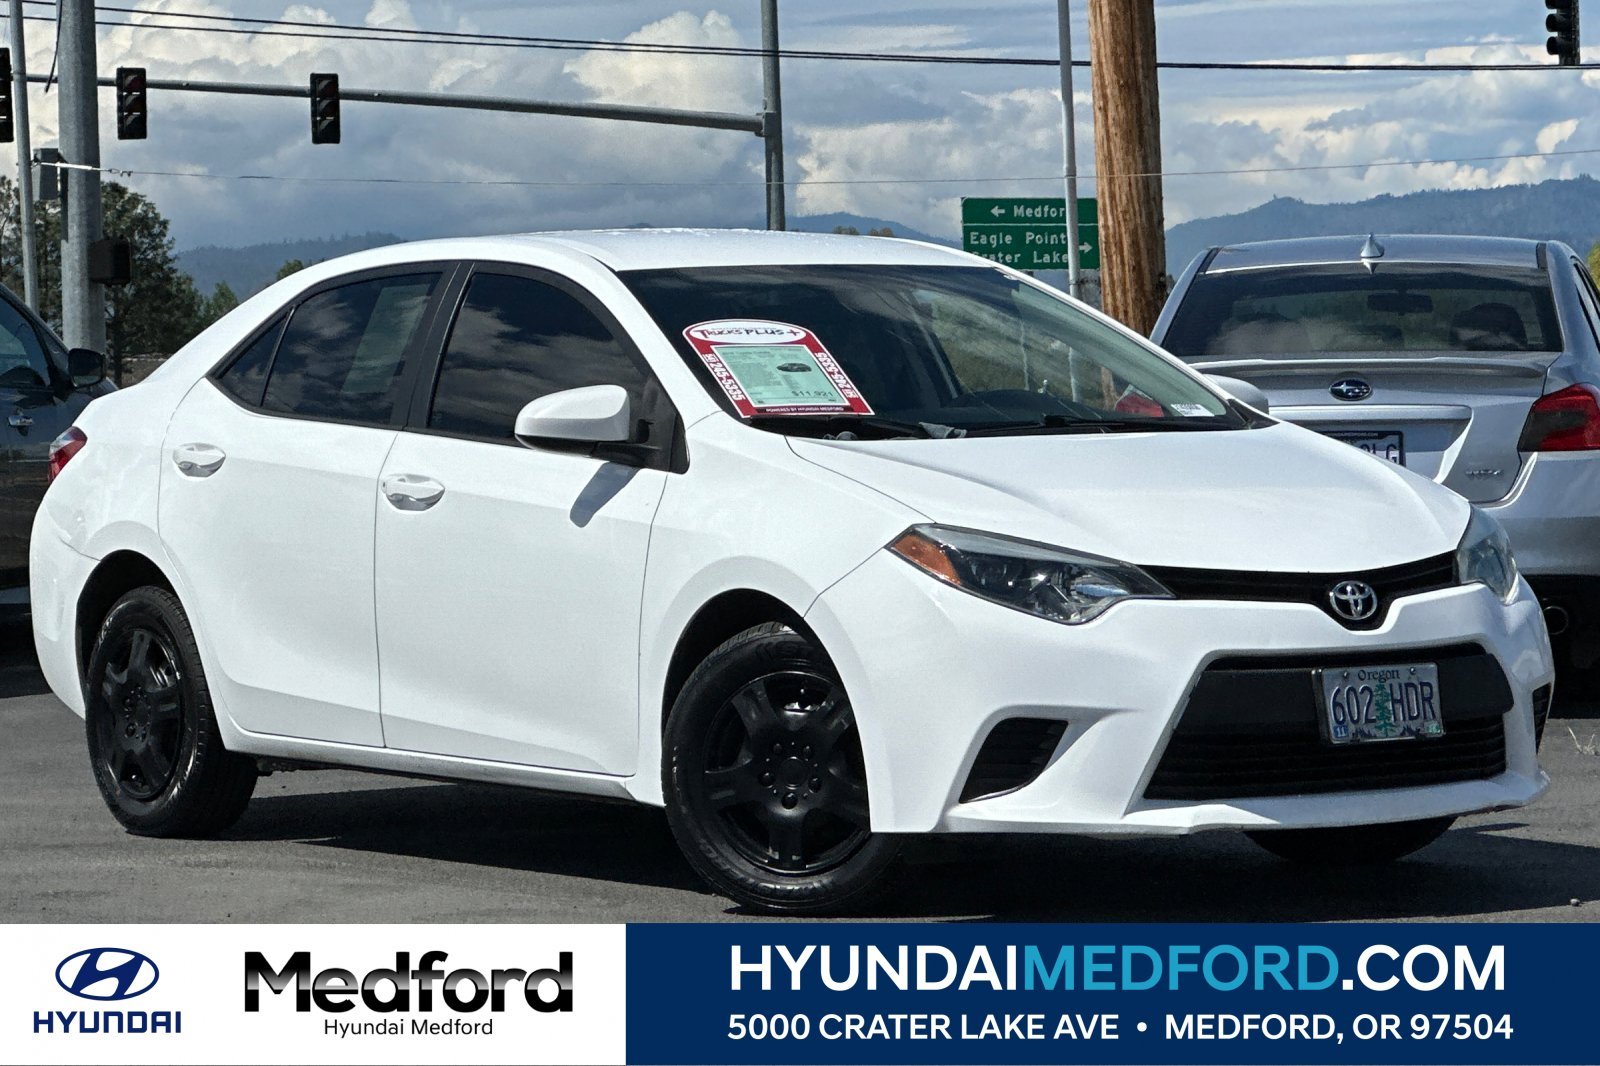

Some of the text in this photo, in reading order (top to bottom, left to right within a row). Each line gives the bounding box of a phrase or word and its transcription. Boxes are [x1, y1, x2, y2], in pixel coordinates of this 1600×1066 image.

[1013, 205, 1066, 218] Medfor
[970, 232, 1067, 247] Eagle Point
[971, 251, 1069, 263] rater Lake
[711, 361, 746, 400] 245-5335
[1358, 669, 1400, 682] Oregon
[1331, 681, 1436, 725] 602 HDR
